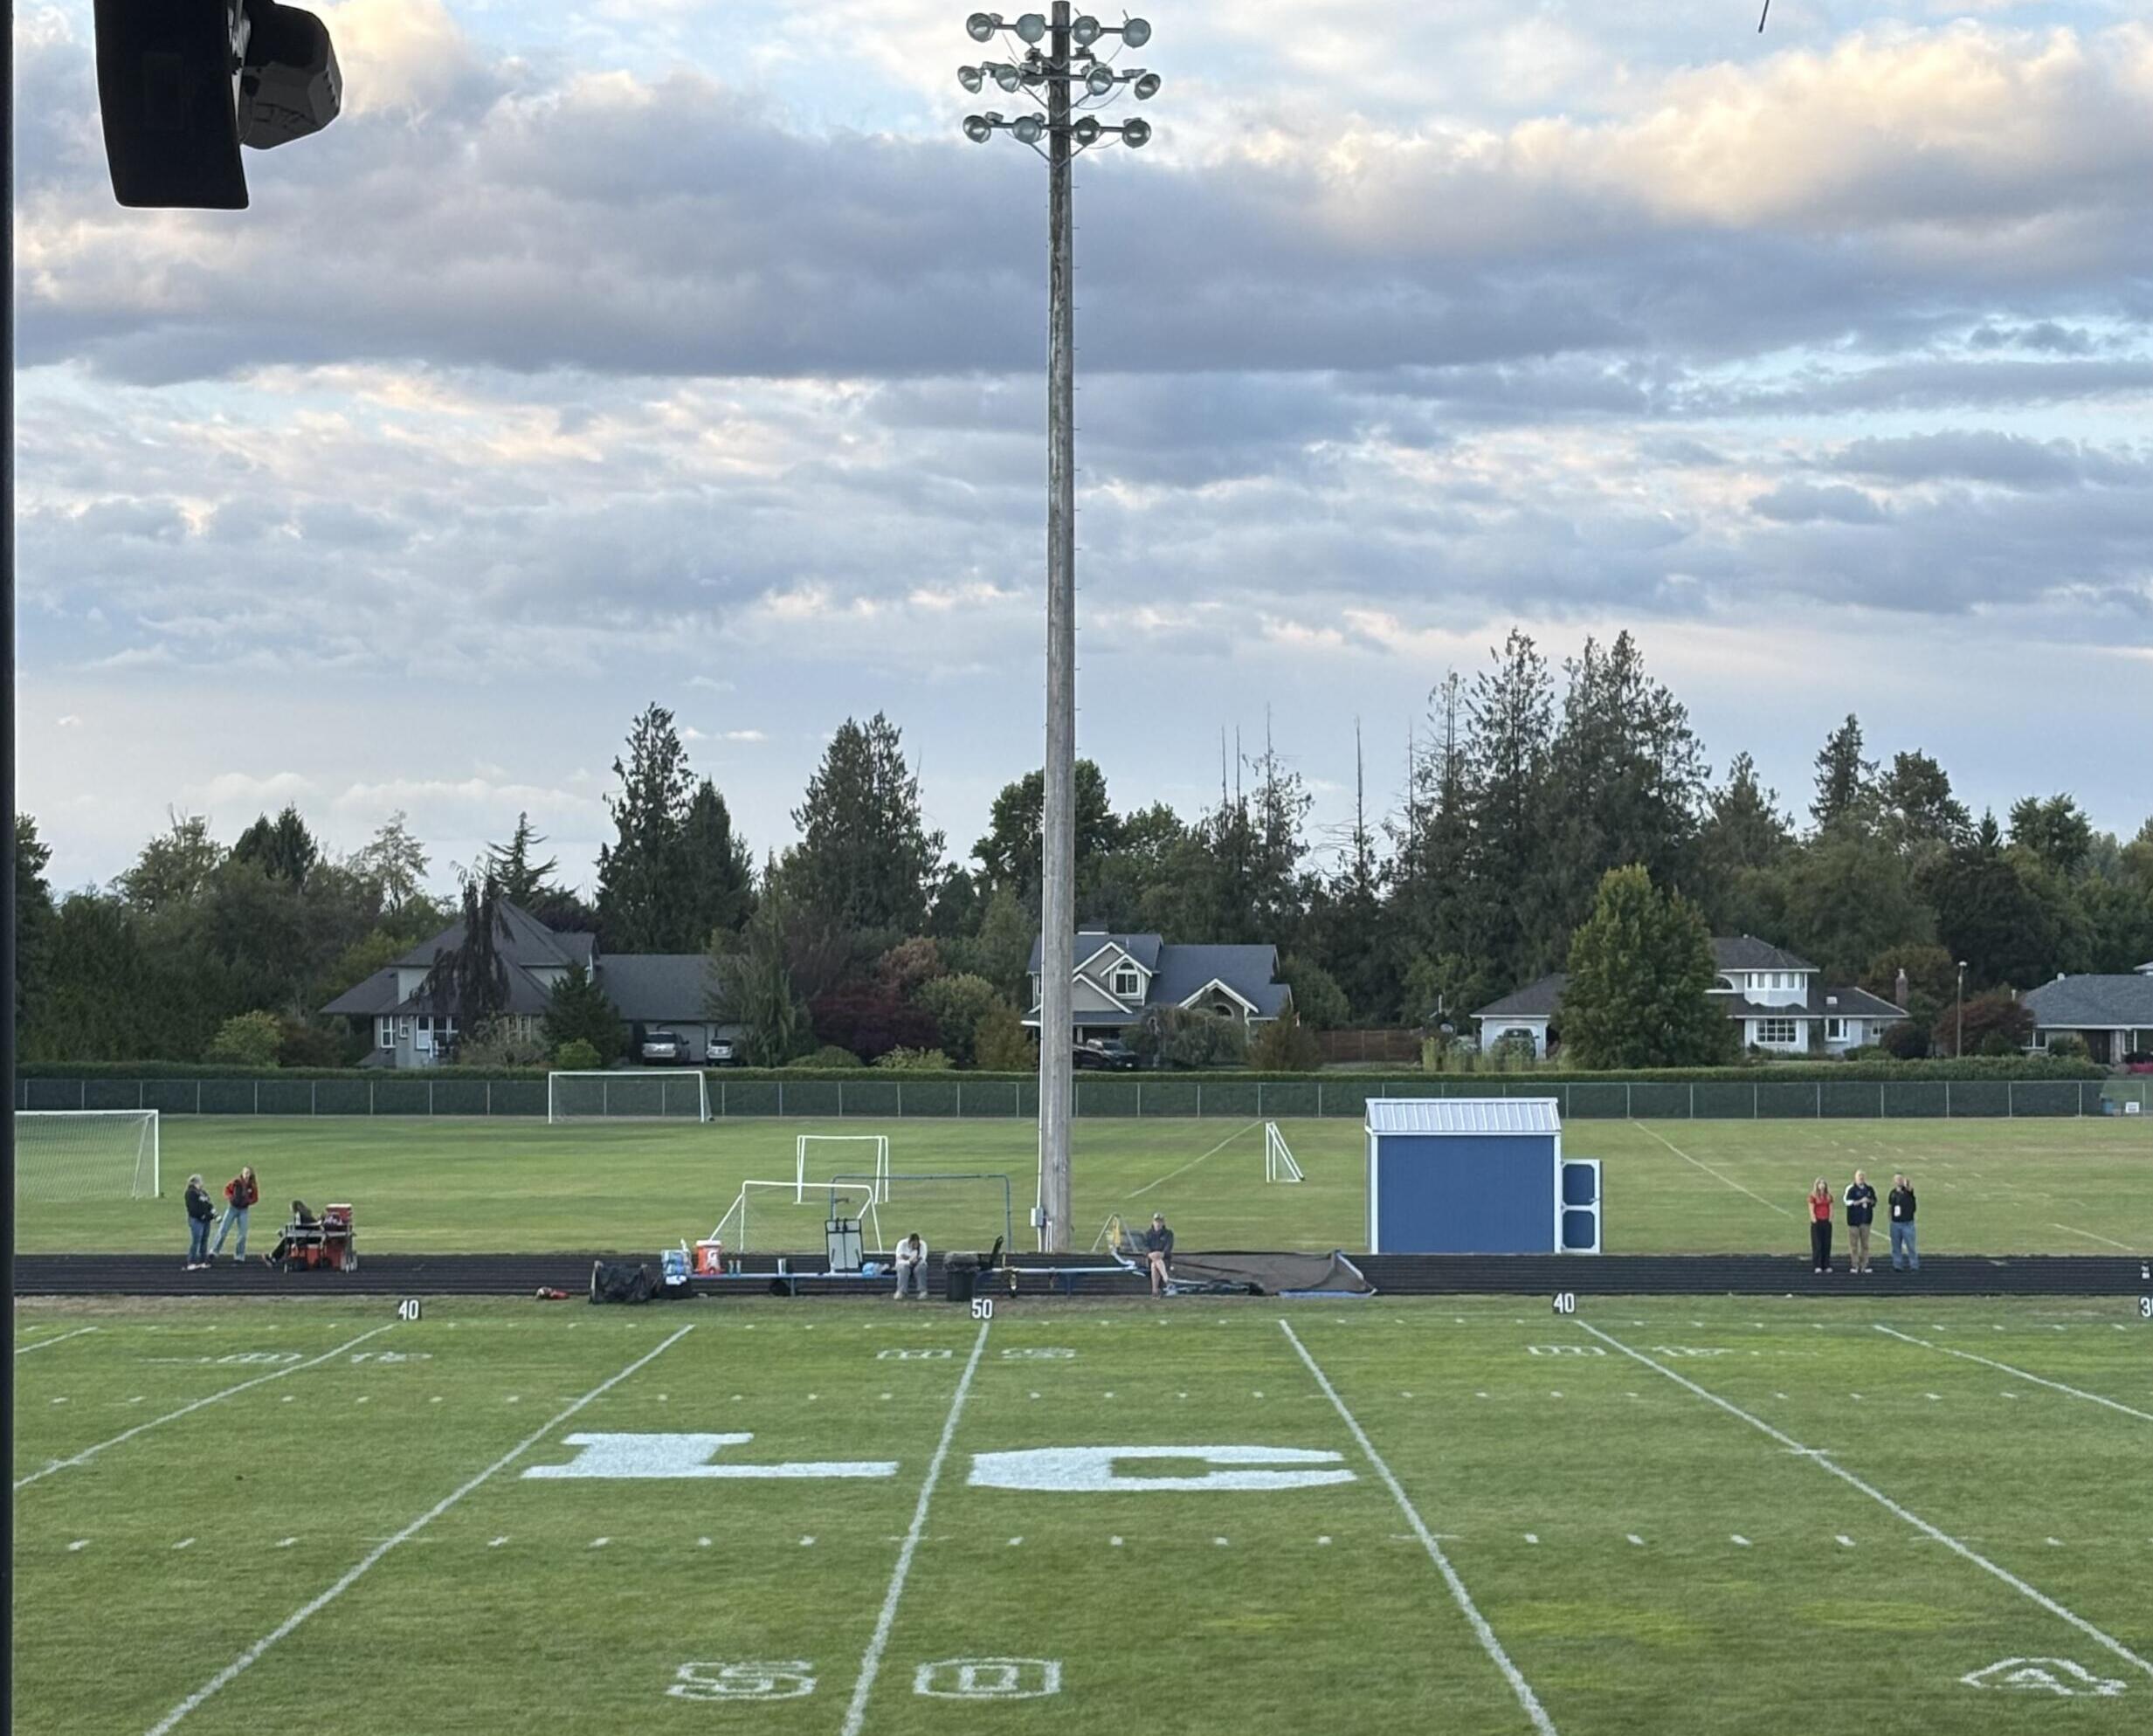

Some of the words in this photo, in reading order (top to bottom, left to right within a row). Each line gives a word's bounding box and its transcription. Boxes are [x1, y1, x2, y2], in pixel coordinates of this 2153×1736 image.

[398, 1299, 419, 1320] 40
[971, 1298, 993, 1319] 50
[1553, 1292, 1575, 1313] 40
